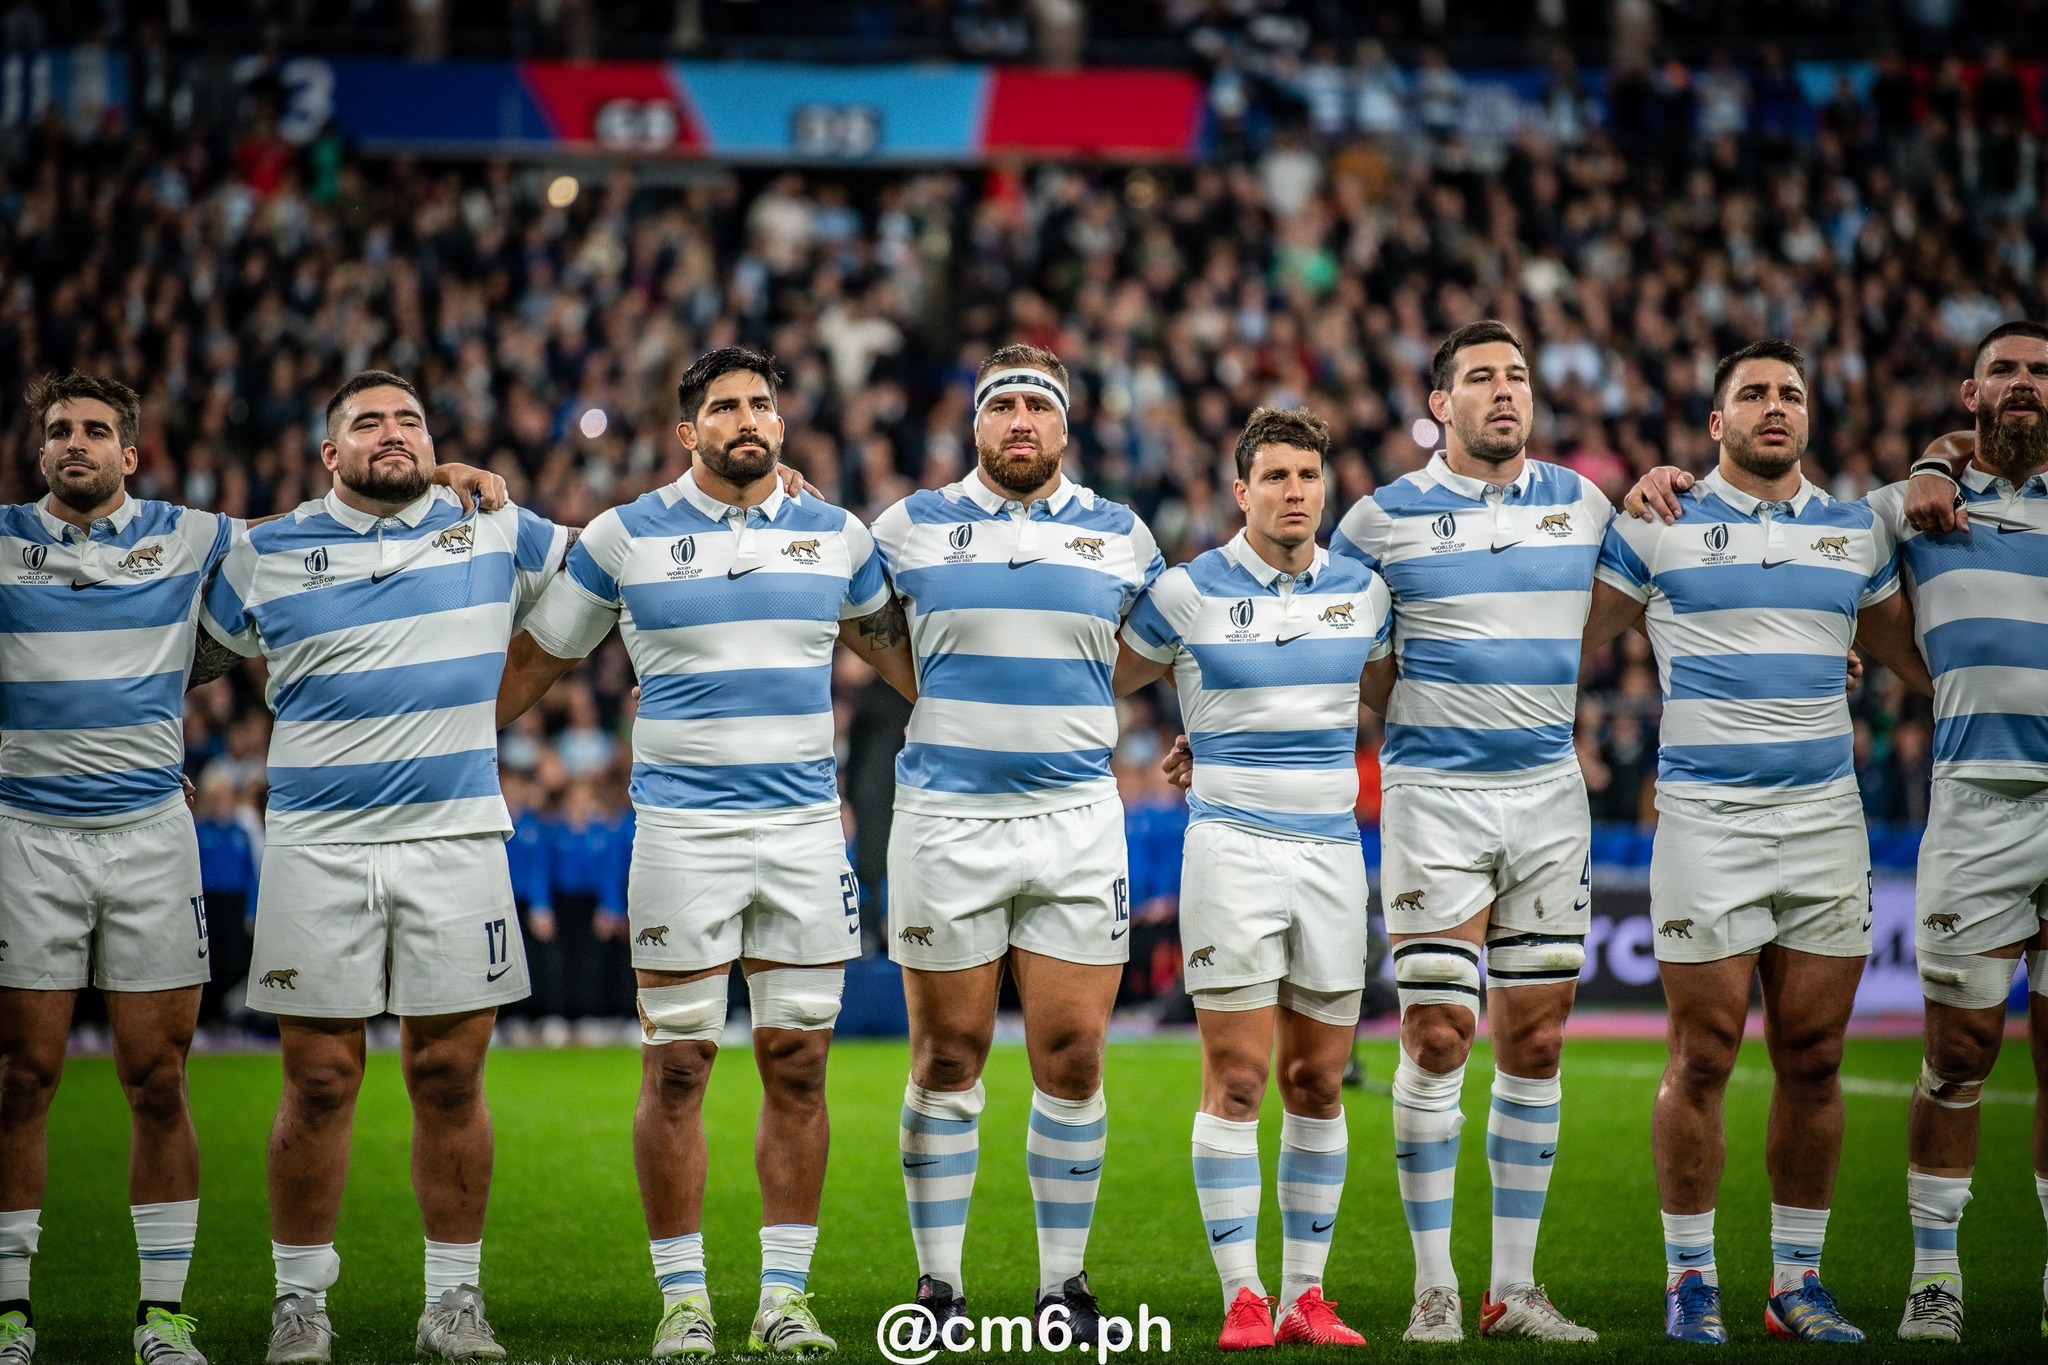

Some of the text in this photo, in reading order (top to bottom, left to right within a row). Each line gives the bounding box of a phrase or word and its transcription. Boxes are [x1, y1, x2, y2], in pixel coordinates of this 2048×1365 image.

[302, 579, 323, 587] WORLD
[1113, 877, 1128, 921] 18
[485, 918, 506, 965] 17
